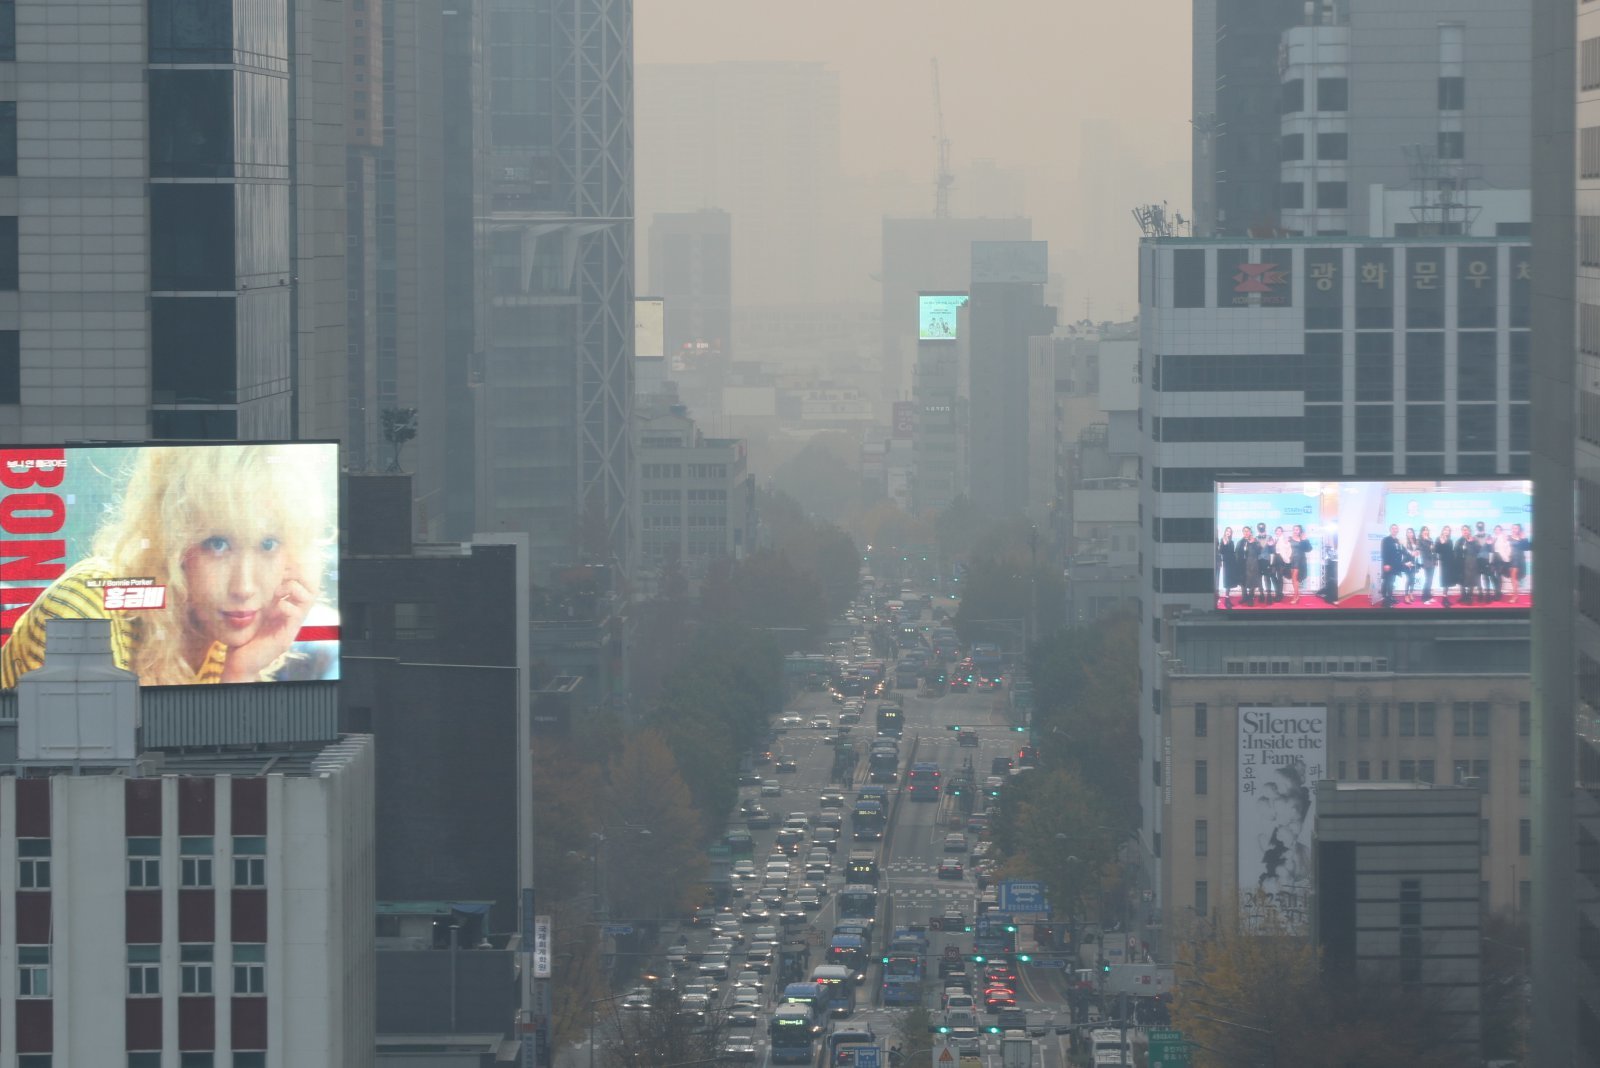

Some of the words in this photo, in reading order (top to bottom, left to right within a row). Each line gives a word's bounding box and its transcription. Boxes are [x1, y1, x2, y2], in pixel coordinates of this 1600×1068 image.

[1232, 296, 1261, 304] KOR
[107, 579, 130, 587] Bonnie
[1242, 711, 1322, 734] Silence
[1242, 734, 1294, 749] :Inside
[1297, 734, 1322, 749] the
[1261, 750, 1304, 765] Fame
[1242, 753, 1257, 796] 고요와
